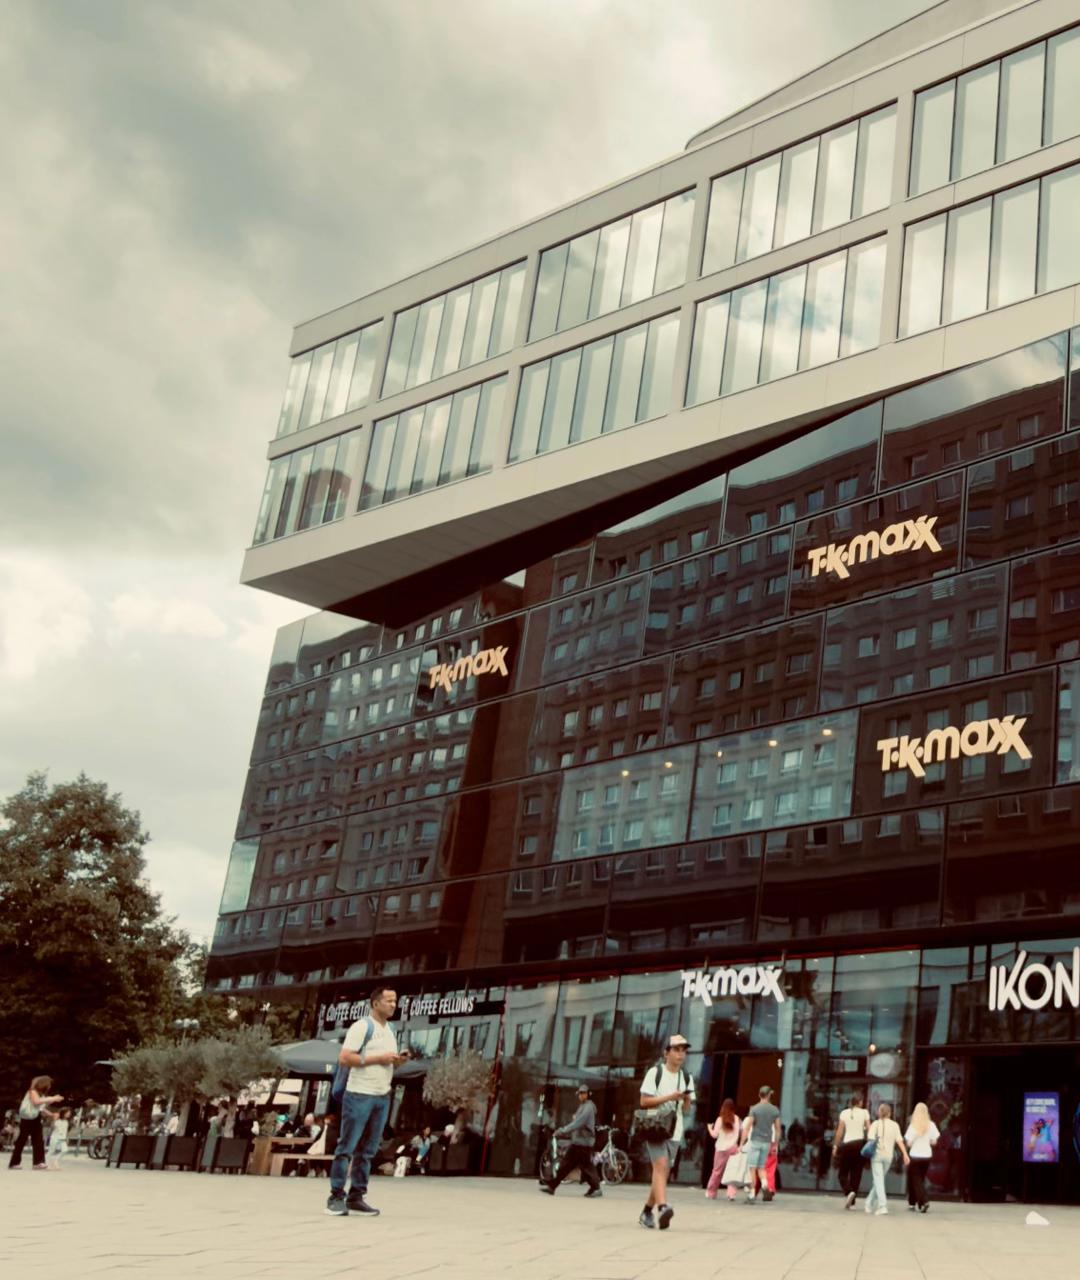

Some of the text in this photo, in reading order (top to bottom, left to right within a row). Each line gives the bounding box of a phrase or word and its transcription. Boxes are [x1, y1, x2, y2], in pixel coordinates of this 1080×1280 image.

[326, 1003, 350, 1022] COFFEE
[409, 996, 475, 1017] COFFEE FELLOWS
